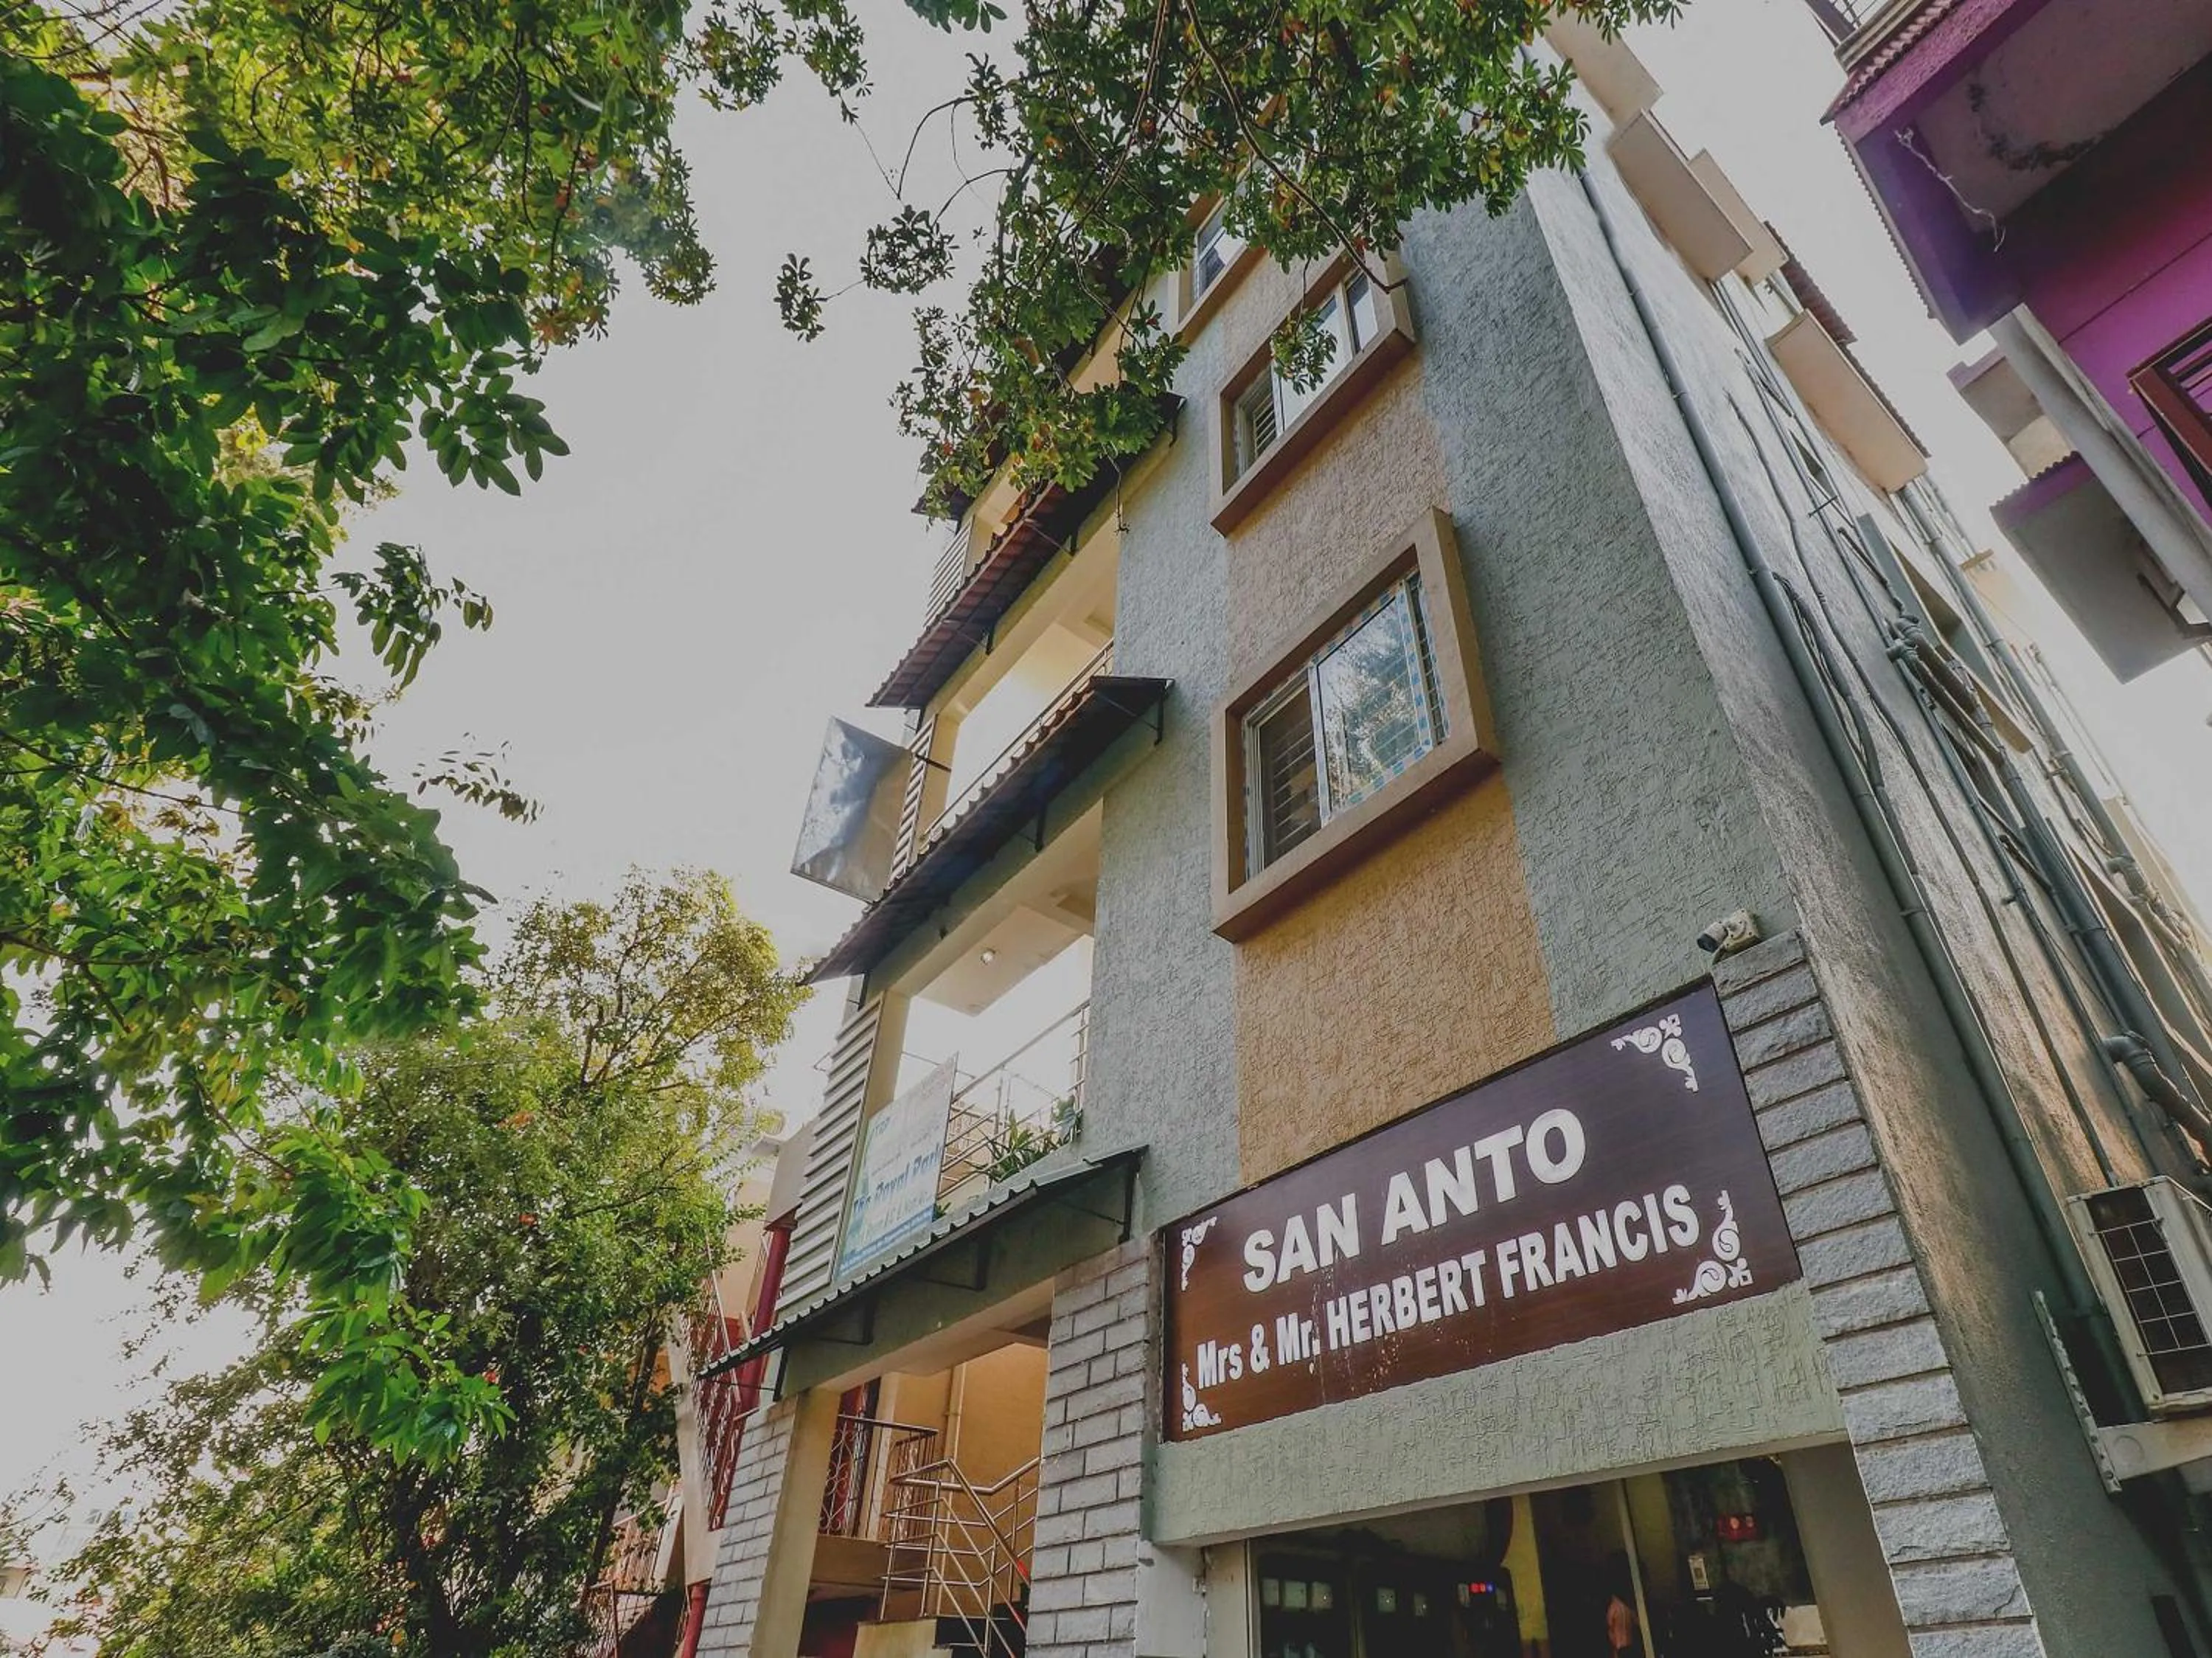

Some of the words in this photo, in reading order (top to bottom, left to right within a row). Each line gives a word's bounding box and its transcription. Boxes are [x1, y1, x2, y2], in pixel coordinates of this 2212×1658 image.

[1197, 1339, 1244, 1390] Mrs
[1249, 1322, 1271, 1374] &
[1276, 1311, 1321, 1366] Mr.
[1326, 1249, 1487, 1351] HERBERT
[1496, 1184, 1700, 1300] FRANCIS
[1242, 1192, 1361, 1293] SAN
[1381, 1108, 1587, 1246] ANTO
